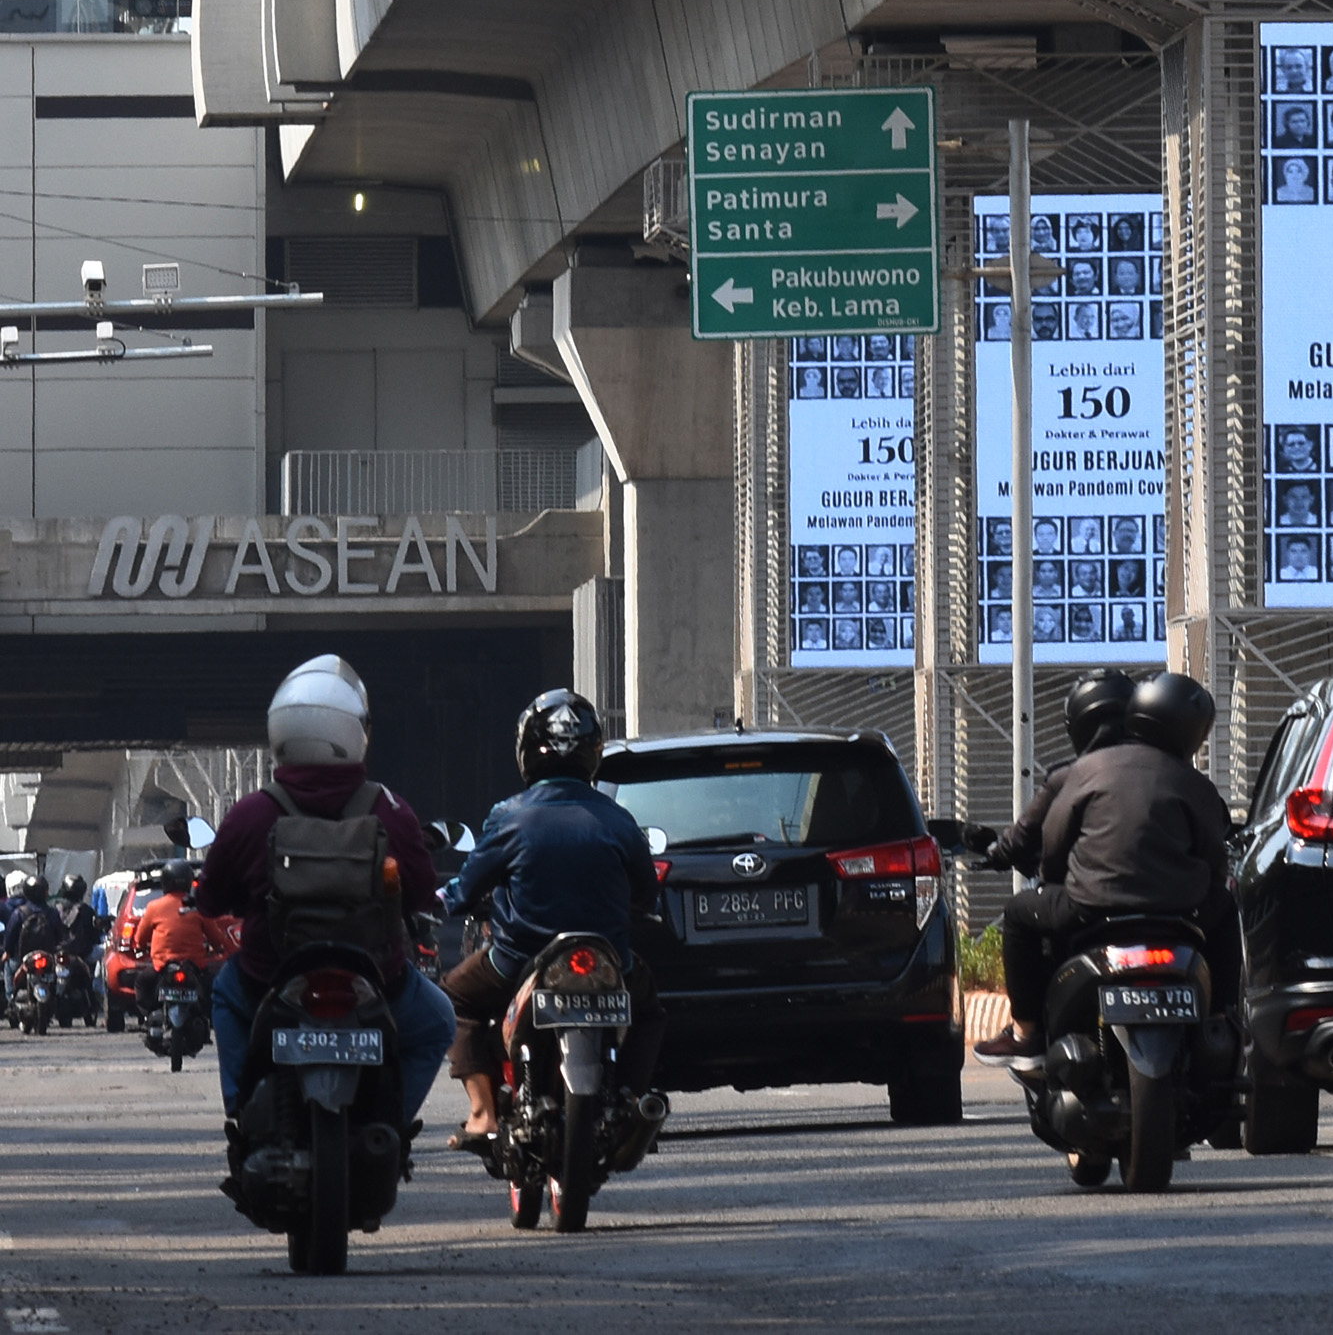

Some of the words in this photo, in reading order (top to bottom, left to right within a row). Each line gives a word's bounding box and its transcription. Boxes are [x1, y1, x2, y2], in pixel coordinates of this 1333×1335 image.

[705, 107, 842, 131] Sudirman
[706, 141, 825, 165] Senayan
[706, 187, 827, 210] Patimura
[707, 220, 792, 241] Santa
[771, 266, 920, 289] Pakubuwono
[772, 296, 824, 318] Keb.
[831, 297, 900, 317] Lama
[1049, 362, 1097, 377] Lebih
[1102, 362, 1135, 376] dari
[1057, 385, 1131, 420] 150
[851, 417, 891, 430] Lebih
[1045, 429, 1084, 439] Dokter
[1100, 429, 1150, 439] Perawat
[847, 473, 880, 481] Dokter
[1068, 479, 1133, 497] Pandemi
[821, 490, 874, 508] GUGUR
[807, 515, 863, 529] Melawan
[223, 516, 498, 595] ASEAN
[699, 896, 709, 914] B
[720, 894, 760, 913] 2854
[774, 892, 804, 910] PFG
[535, 992, 547, 1010] B
[553, 992, 592, 1010] 6195
[1105, 991, 1115, 1006] B
[1121, 990, 1158, 1006] 6555
[276, 1031, 289, 1047] B
[296, 1031, 339, 1047] 4302
